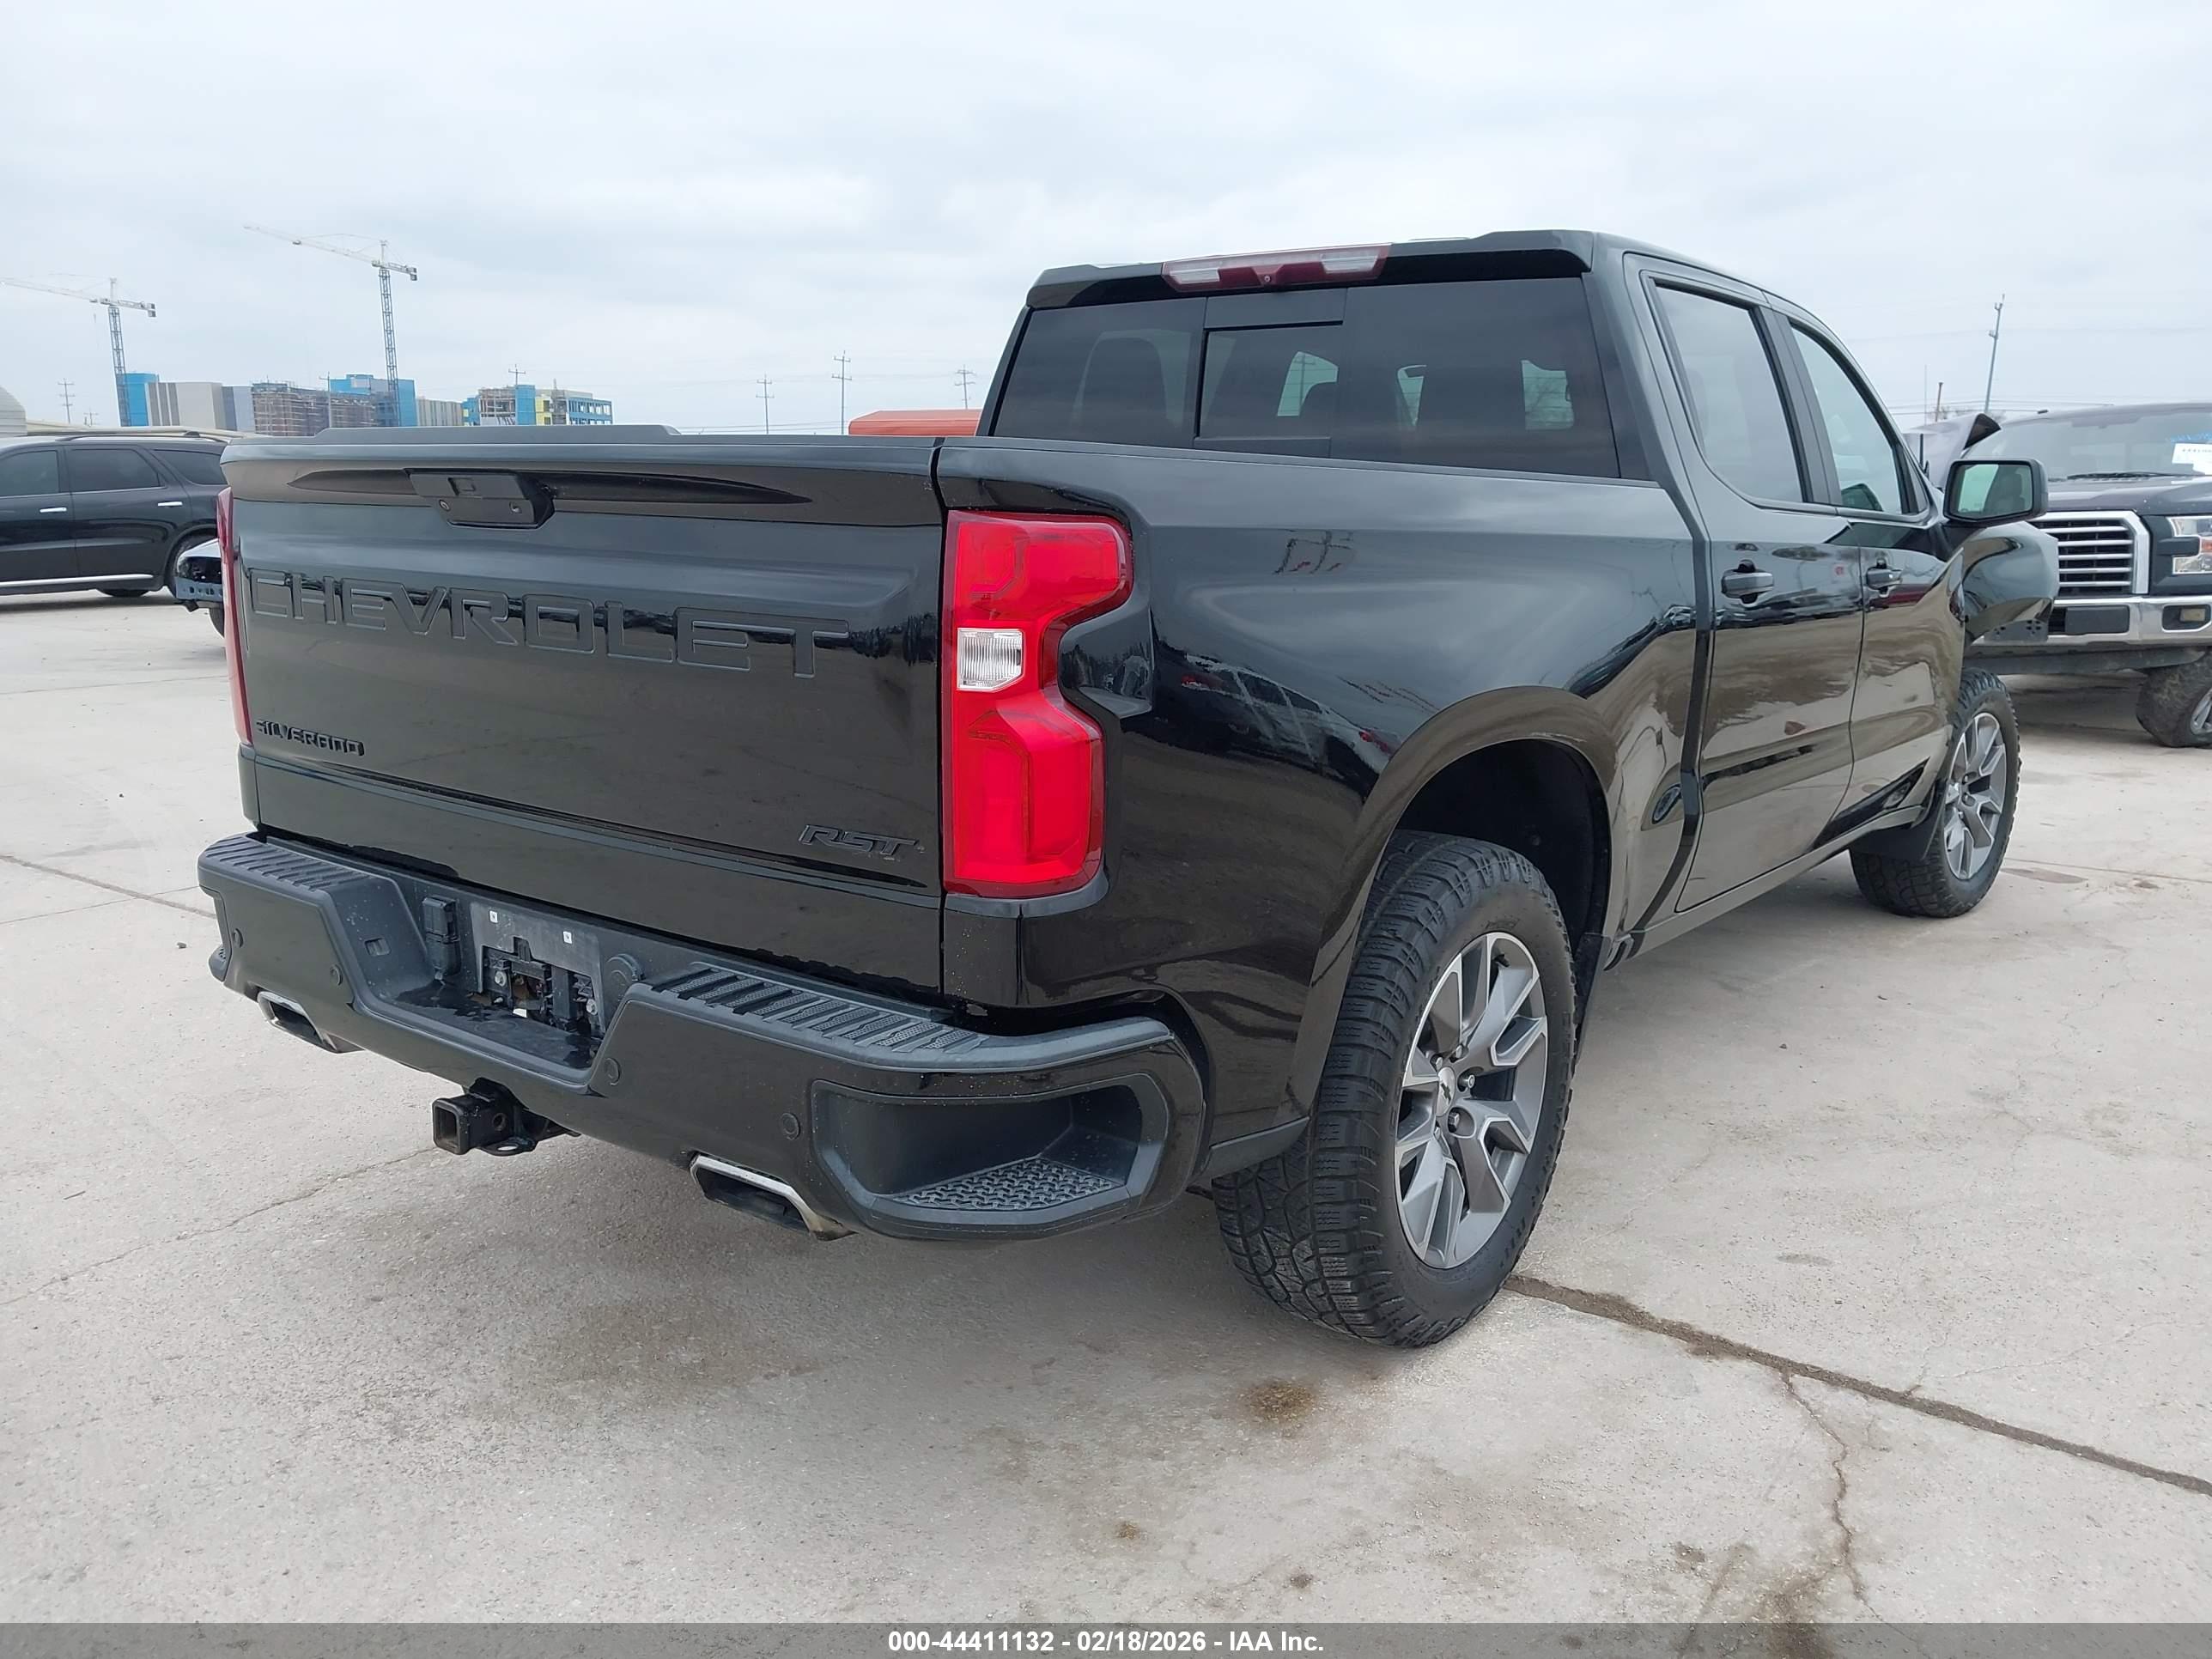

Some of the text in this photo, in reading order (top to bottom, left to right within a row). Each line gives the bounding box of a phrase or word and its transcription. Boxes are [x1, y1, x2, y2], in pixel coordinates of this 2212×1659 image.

[249, 567, 849, 679] CHEVROLET
[256, 720, 365, 757] SILVERADO
[798, 823, 920, 856] RST
